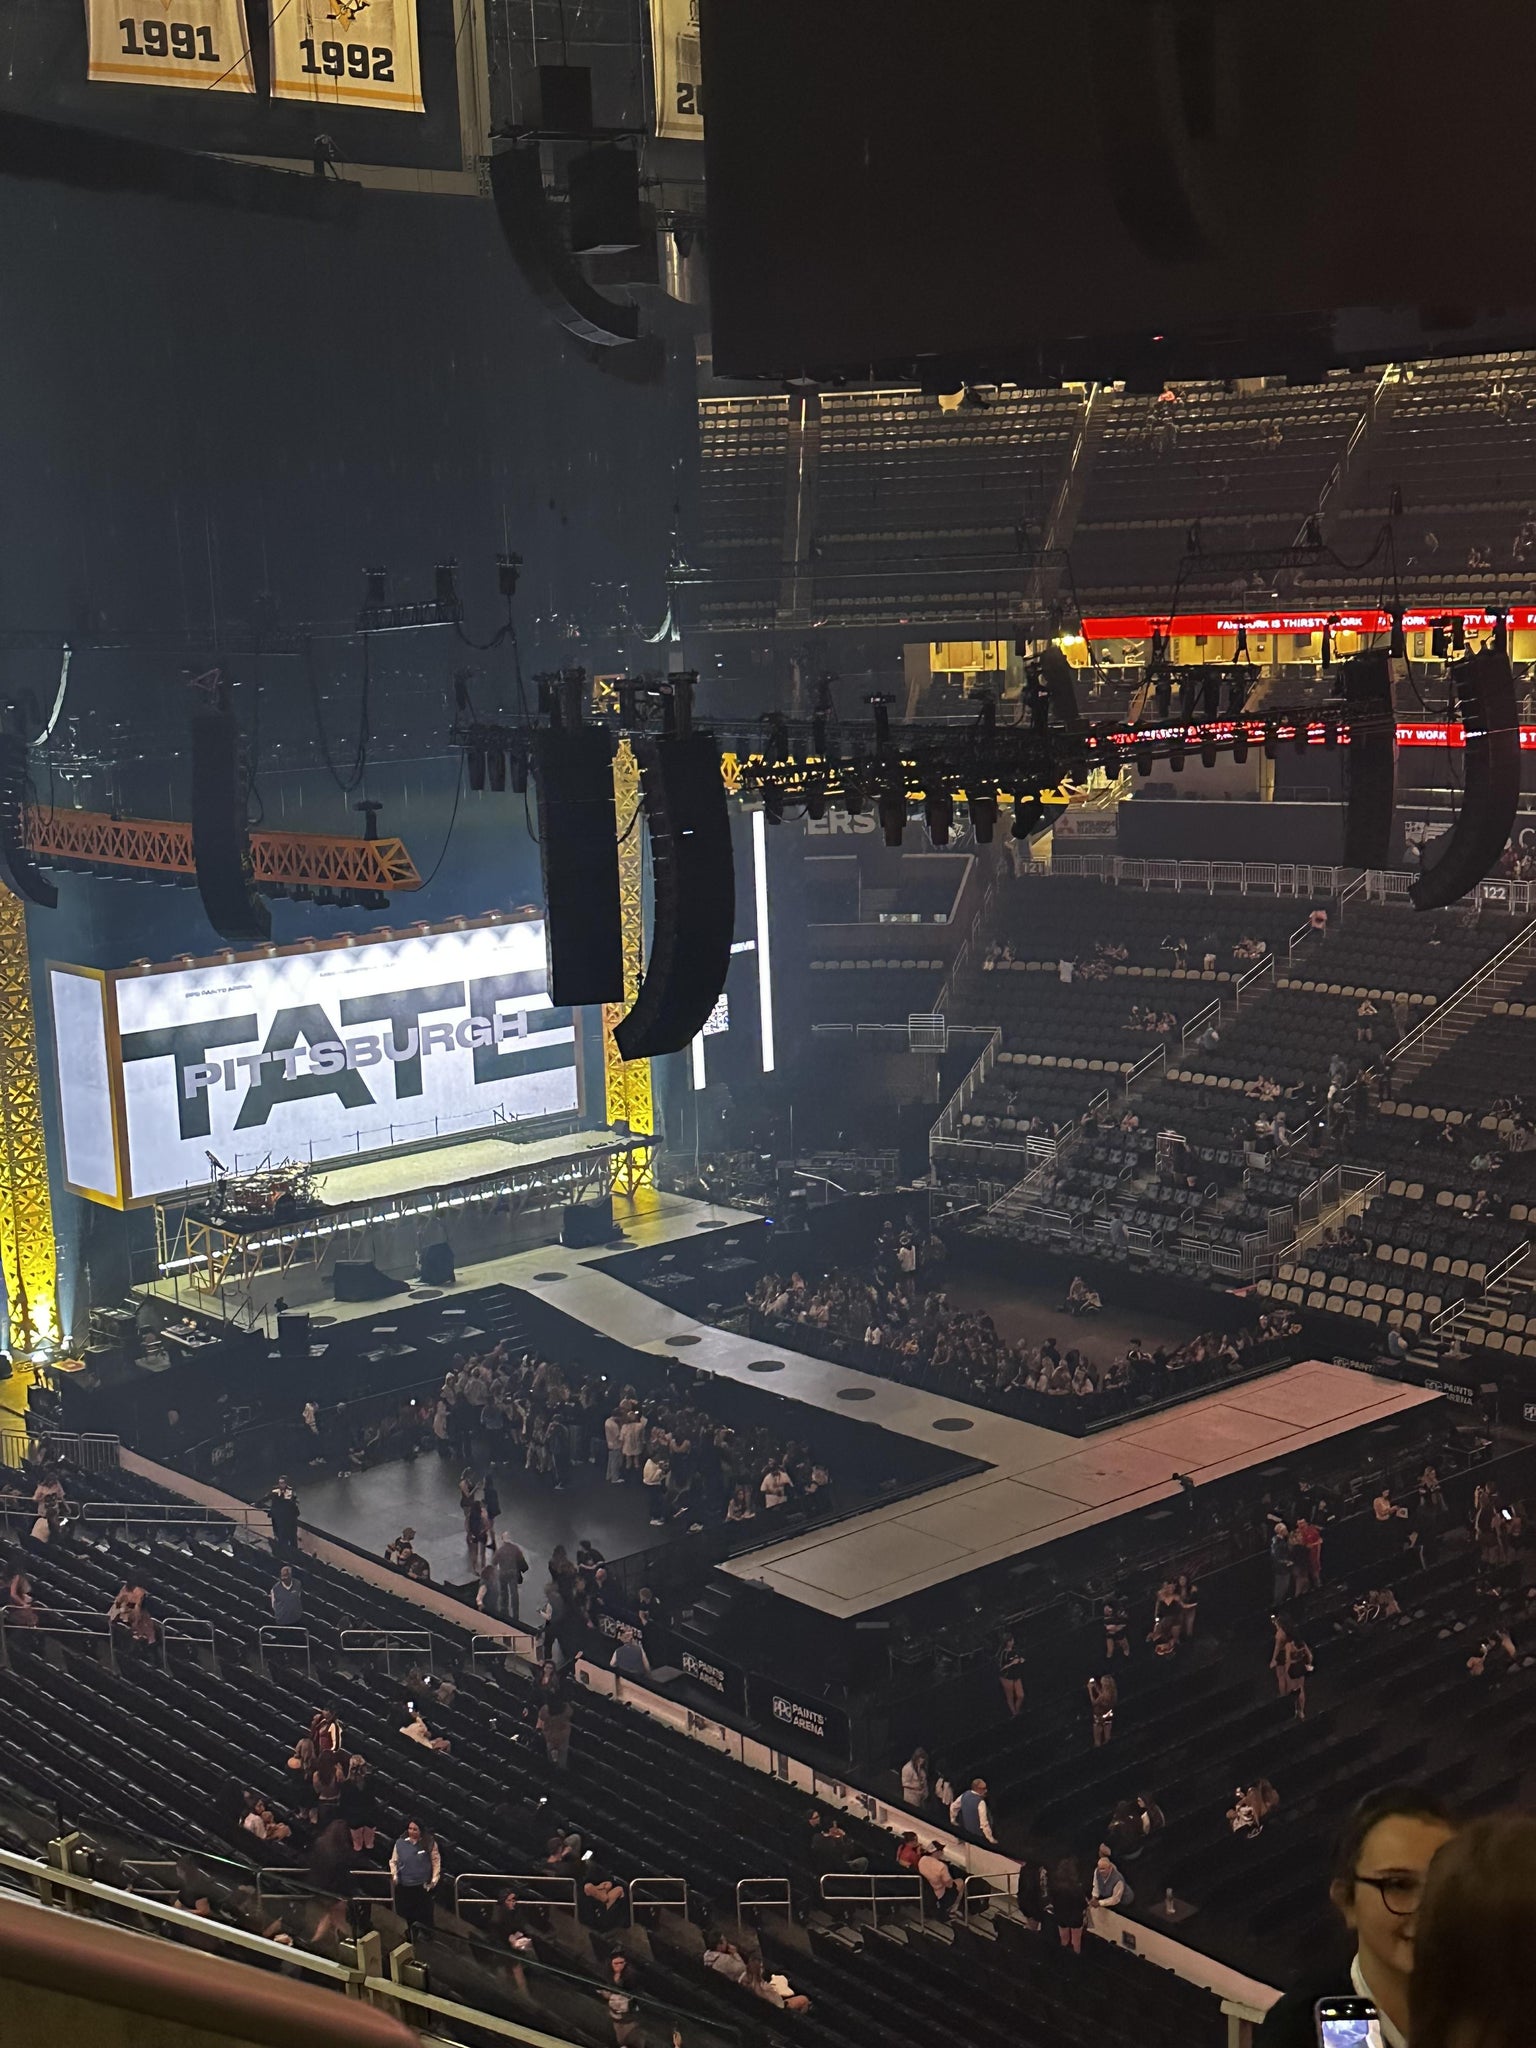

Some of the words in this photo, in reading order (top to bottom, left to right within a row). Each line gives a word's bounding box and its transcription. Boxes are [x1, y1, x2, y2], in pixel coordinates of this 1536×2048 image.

[119, 18, 220, 62] 1991
[300, 39, 395, 83] 1992
[1416, 729, 1447, 740] WORK
[1483, 886, 1506, 899] 122
[122, 968, 576, 1141] TATE
[184, 1010, 528, 1100] PITTSBURGH
[1443, 1382, 1474, 1397] PAINTS
[698, 1660, 725, 1681] PAINTS
[792, 1703, 825, 1725] PAINTS
[793, 1716, 824, 1737] ARENA
